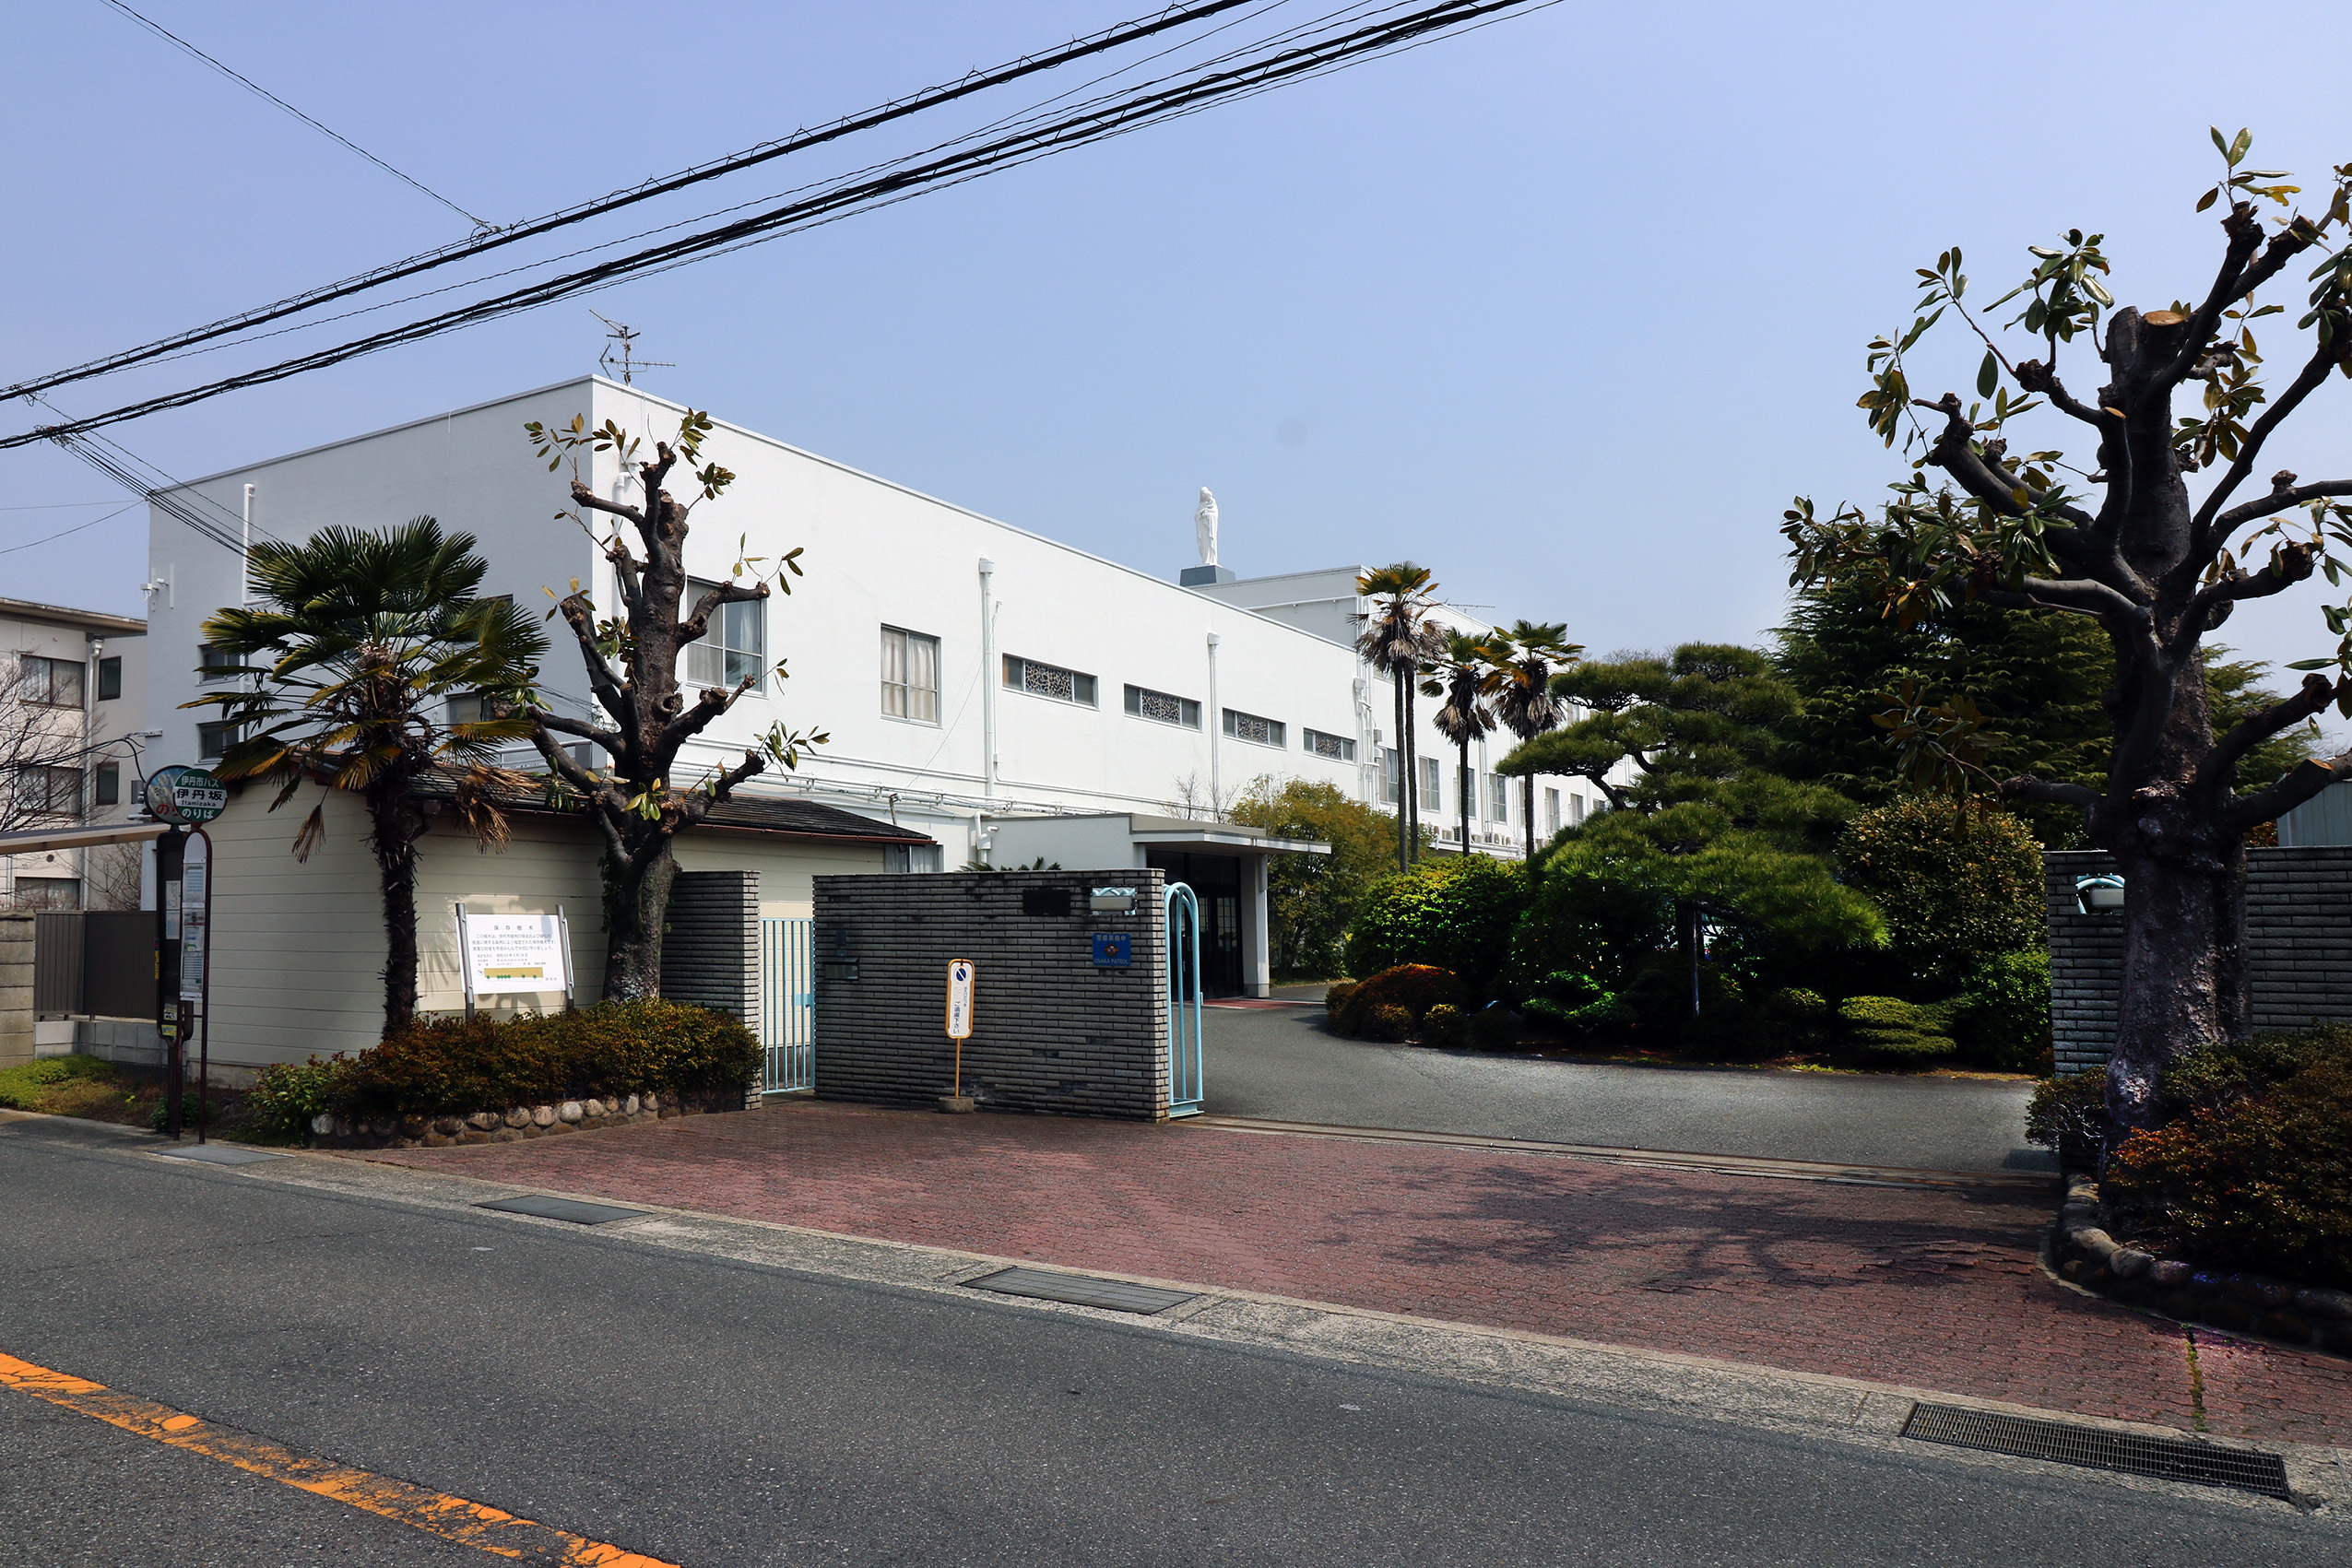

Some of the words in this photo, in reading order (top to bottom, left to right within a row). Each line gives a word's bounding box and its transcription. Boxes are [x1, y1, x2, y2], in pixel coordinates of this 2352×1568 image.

[176, 788, 223, 801] 伊丹坂
[182, 808, 215, 819] のりば
